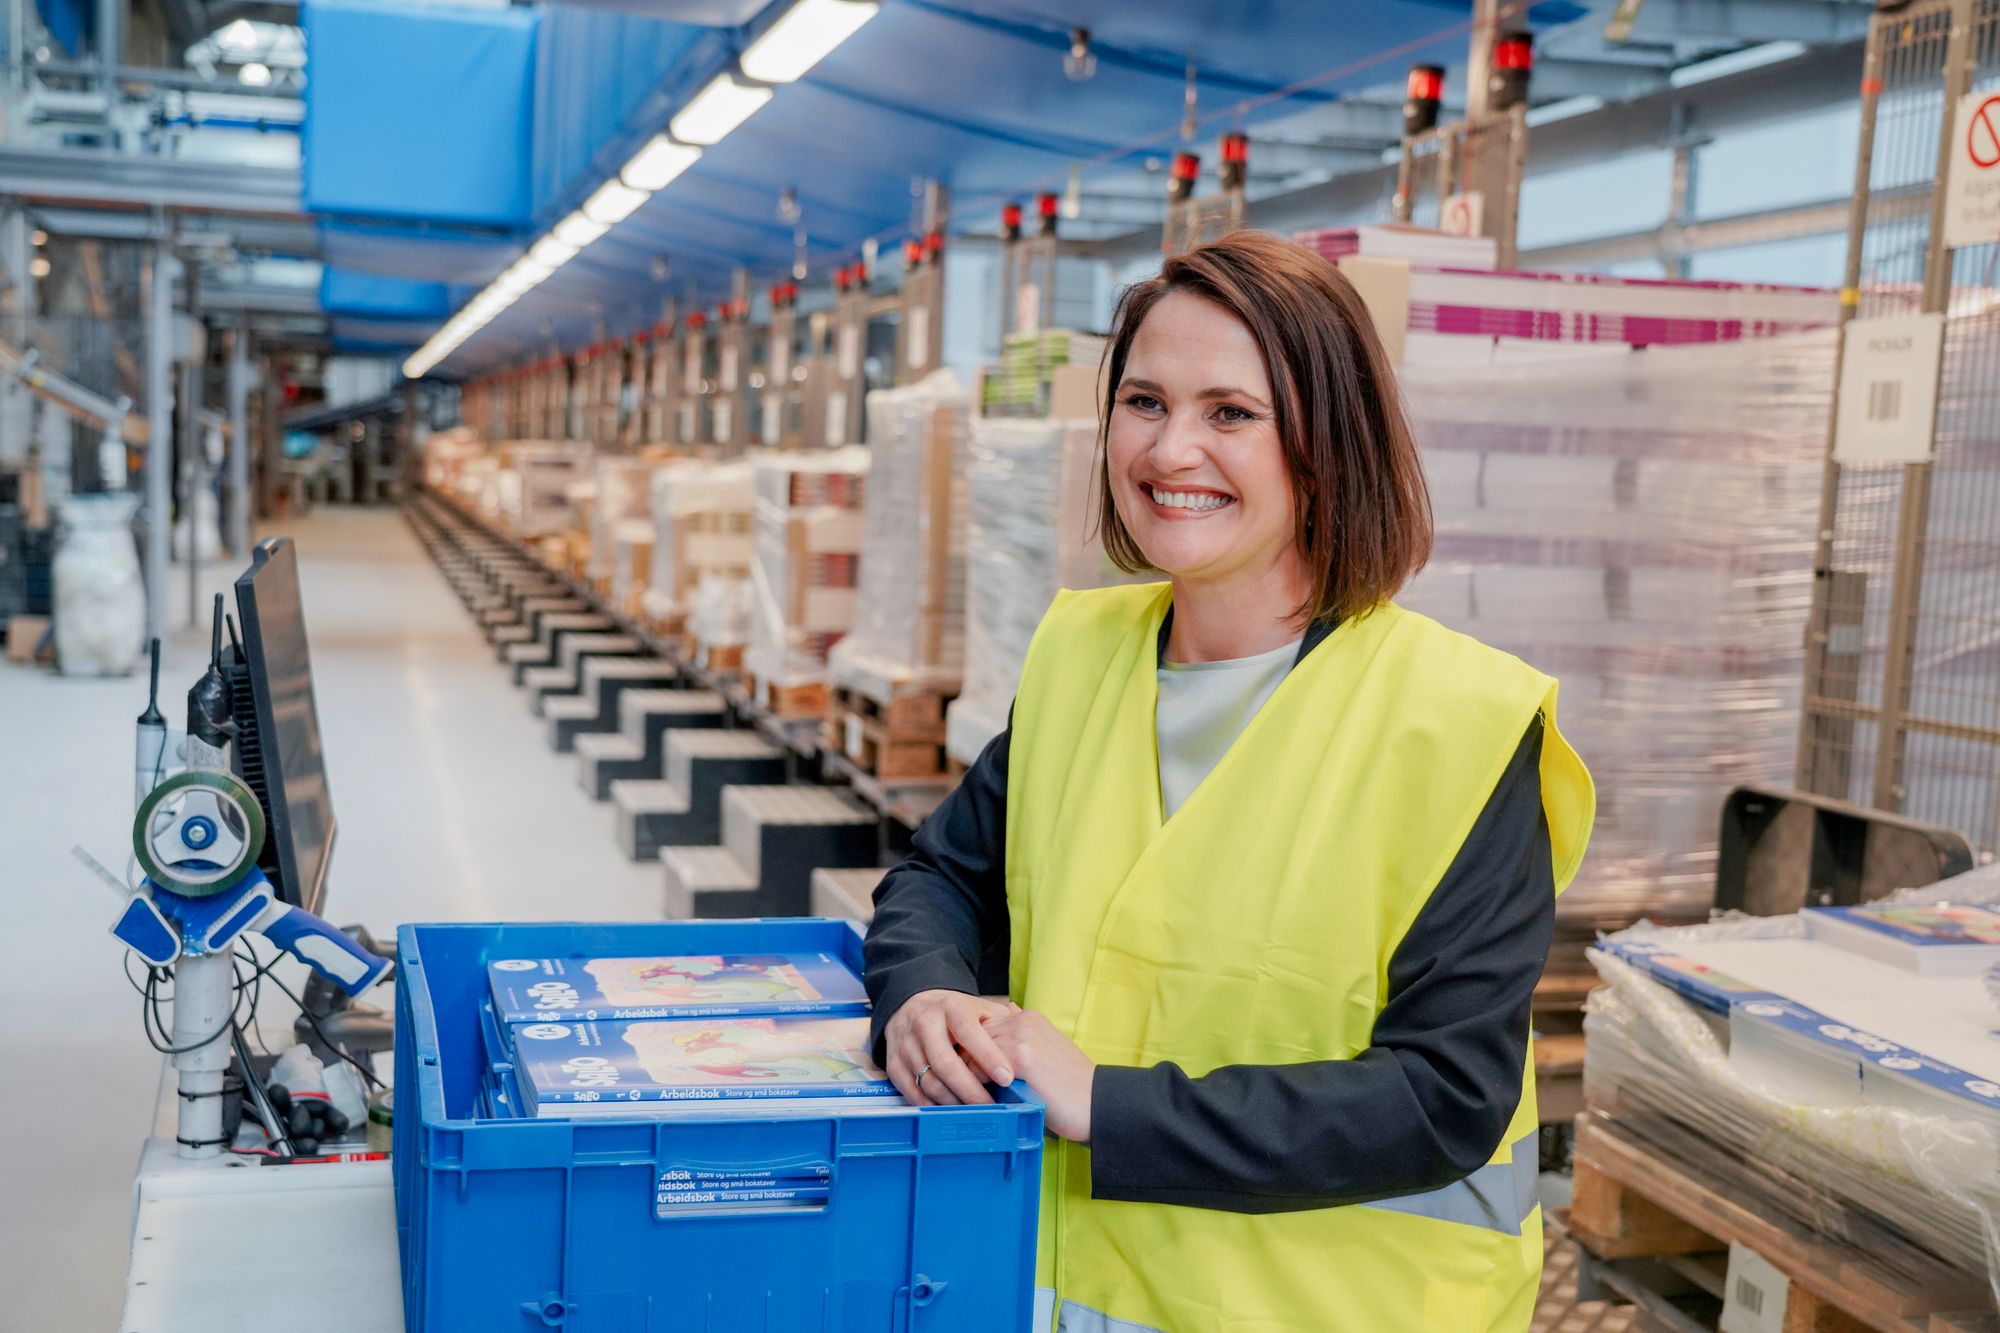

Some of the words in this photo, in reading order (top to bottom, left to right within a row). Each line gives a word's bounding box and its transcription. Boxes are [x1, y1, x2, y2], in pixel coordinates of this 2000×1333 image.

[614, 1007, 668, 1019] Arbeidsbok
[672, 1008, 688, 1016] Store
[690, 1009, 698, 1017] og
[699, 1006, 711, 1015] små
[711, 1006, 740, 1014] bokstaver
[574, 1090, 600, 1101] SALTO
[659, 1088, 720, 1099] Arbeidsbok
[725, 1089, 743, 1097] Store
[745, 1090, 753, 1099] og
[754, 1087, 767, 1097] små
[768, 1087, 800, 1096] bokstaver
[701, 1181, 720, 1189] Store
[720, 1181, 730, 1189] og
[730, 1180, 744, 1188] små
[744, 1179, 776, 1187] bokstaver
[656, 1191, 716, 1203] Arbeidsbok
[721, 1192, 739, 1201] Store
[739, 1193, 749, 1201] og
[750, 1191, 763, 1200] små
[764, 1190, 796, 1199] bokstaver
